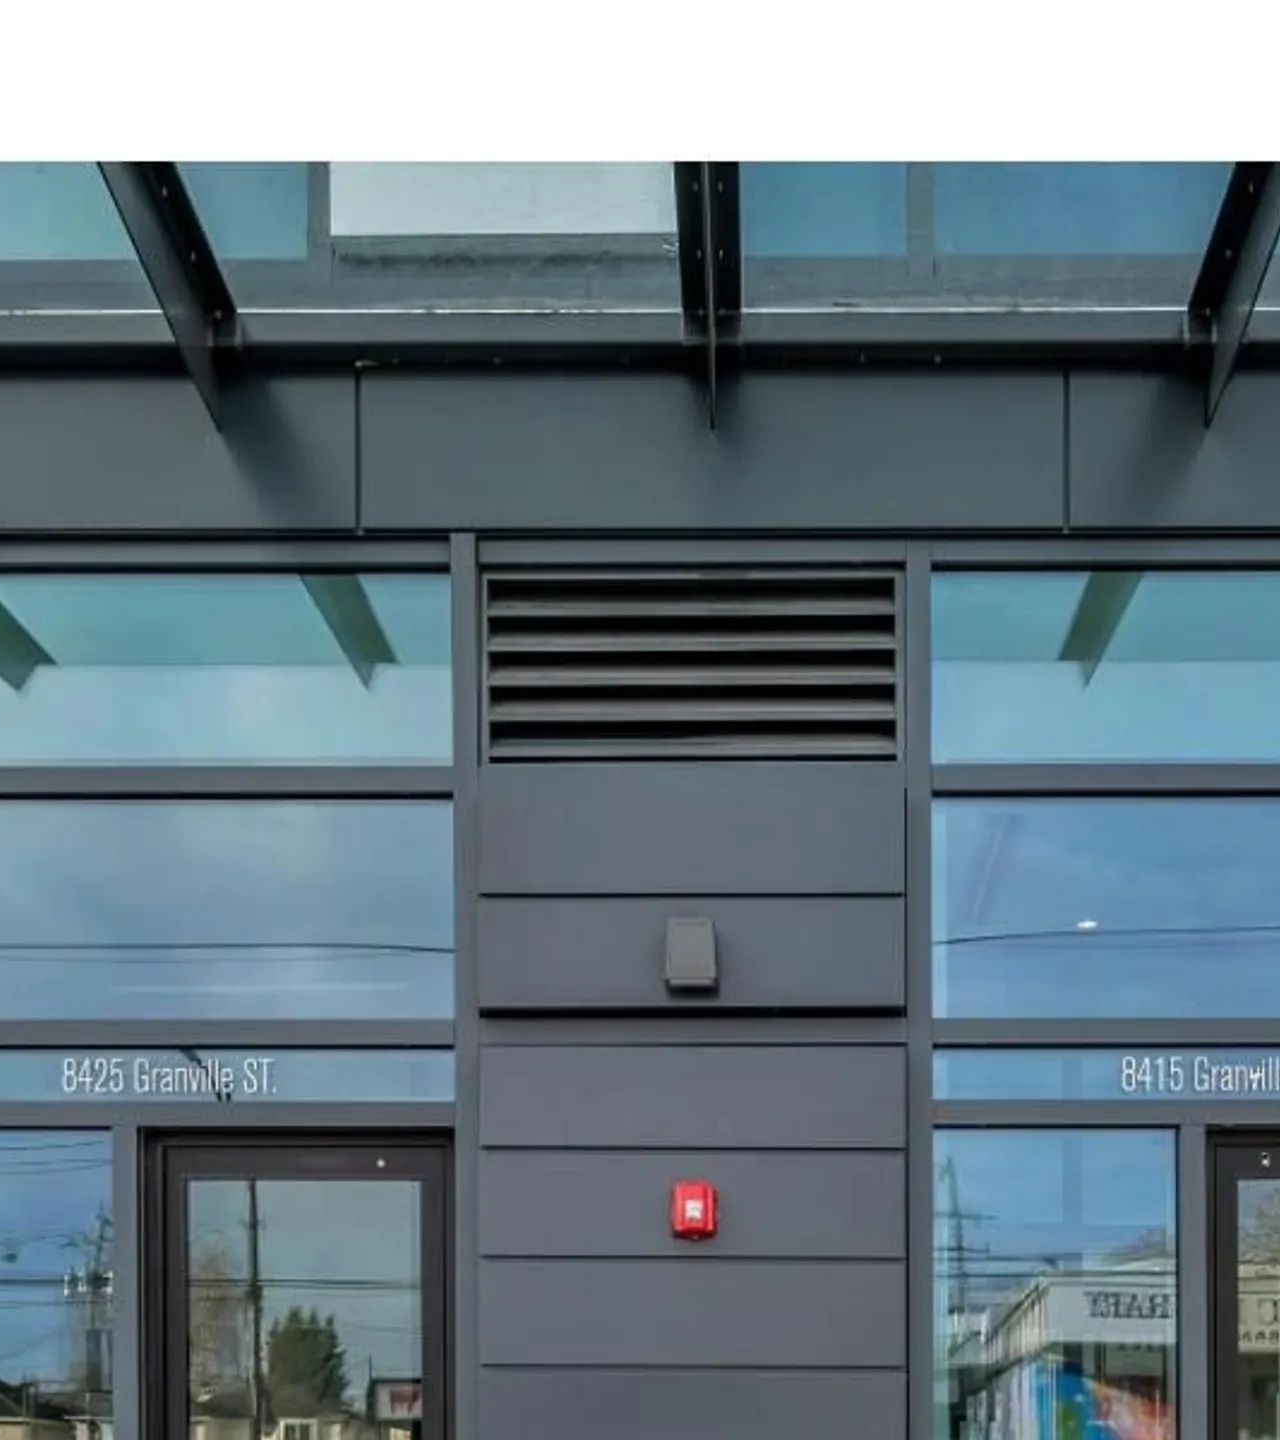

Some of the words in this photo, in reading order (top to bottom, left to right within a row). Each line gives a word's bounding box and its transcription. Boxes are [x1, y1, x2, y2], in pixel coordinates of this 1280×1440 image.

[62, 1057, 124, 1093] 8425
[133, 1057, 234, 1094] Granville
[243, 1057, 277, 1094] ST.
[1121, 1055, 1184, 1092] 8415
